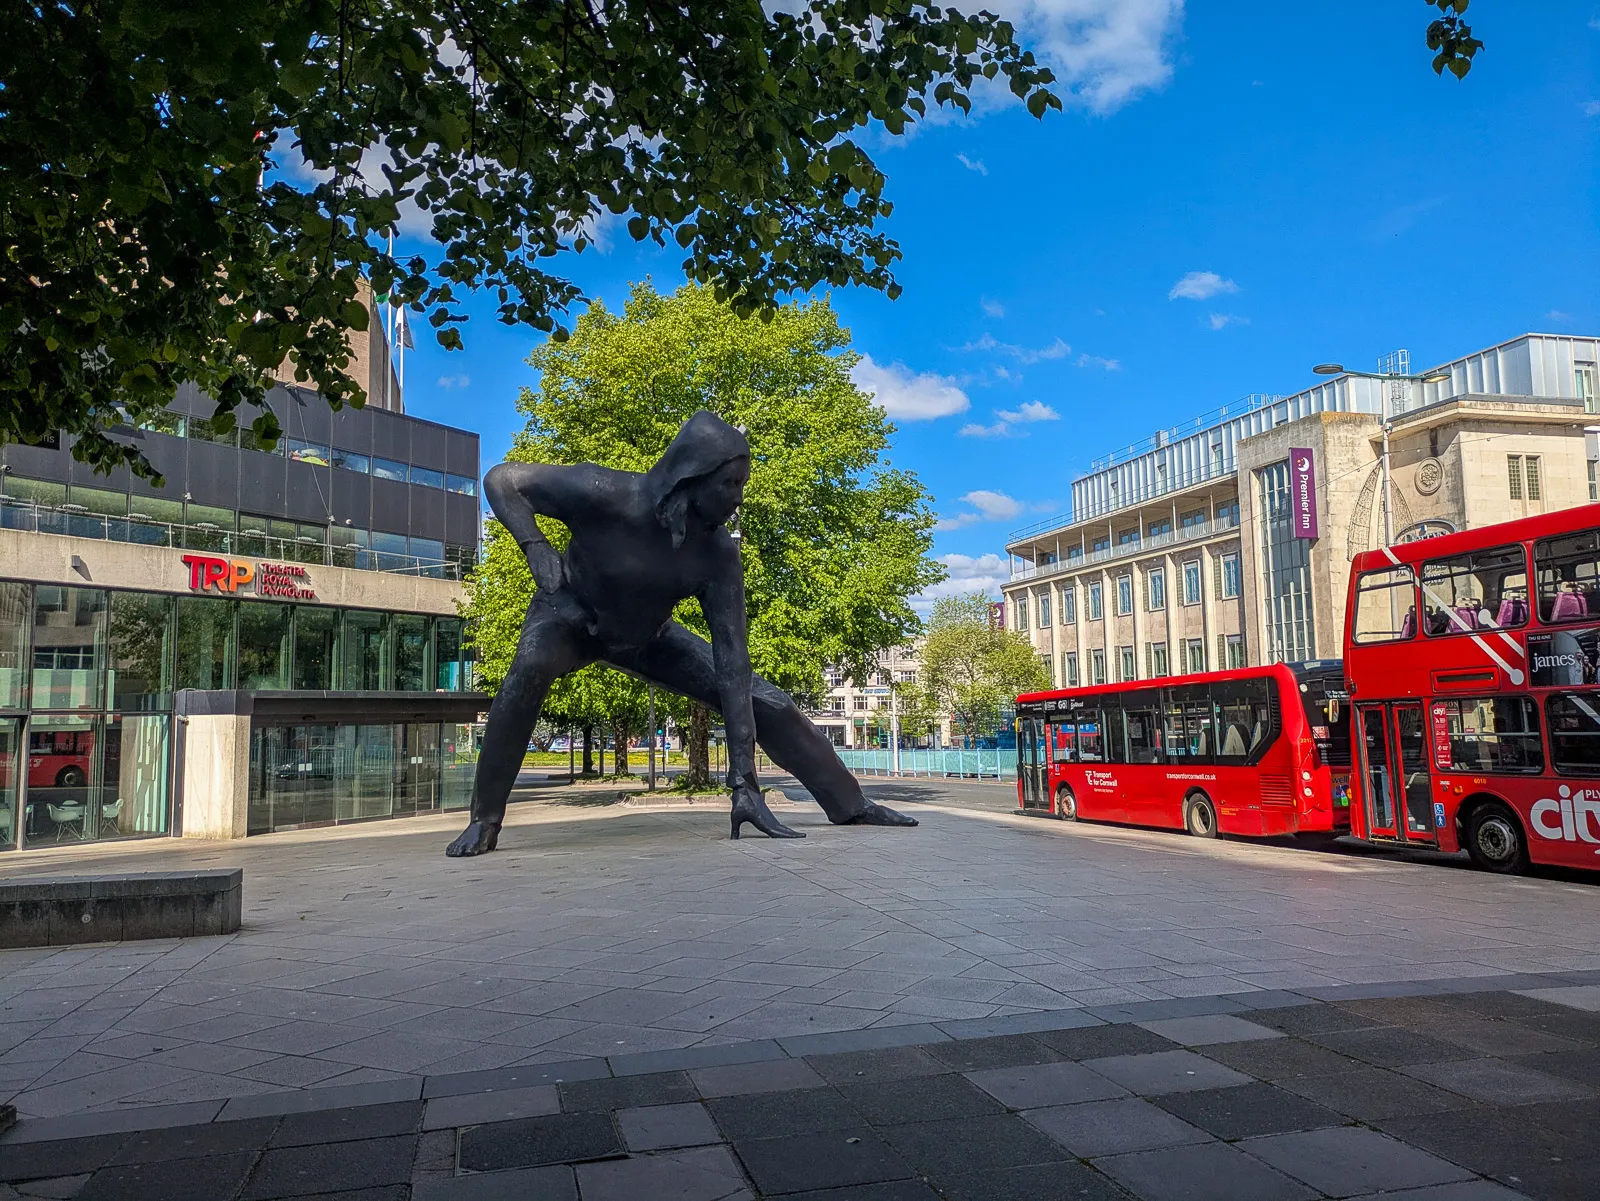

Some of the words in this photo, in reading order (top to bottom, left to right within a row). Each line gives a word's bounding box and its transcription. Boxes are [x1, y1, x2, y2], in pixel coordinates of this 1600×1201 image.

[1299, 474, 1310, 512] Premier
[1302, 513, 1311, 529] Inn
[182, 554, 255, 592] TRP
[261, 562, 305, 577] THEATRE
[263, 574, 295, 586] ROYAL
[262, 584, 316, 599] PLYMOUTH
[1532, 652, 1576, 673] james
[1093, 770, 1112, 779] Transport
[1099, 779, 1118, 787] Cornwall
